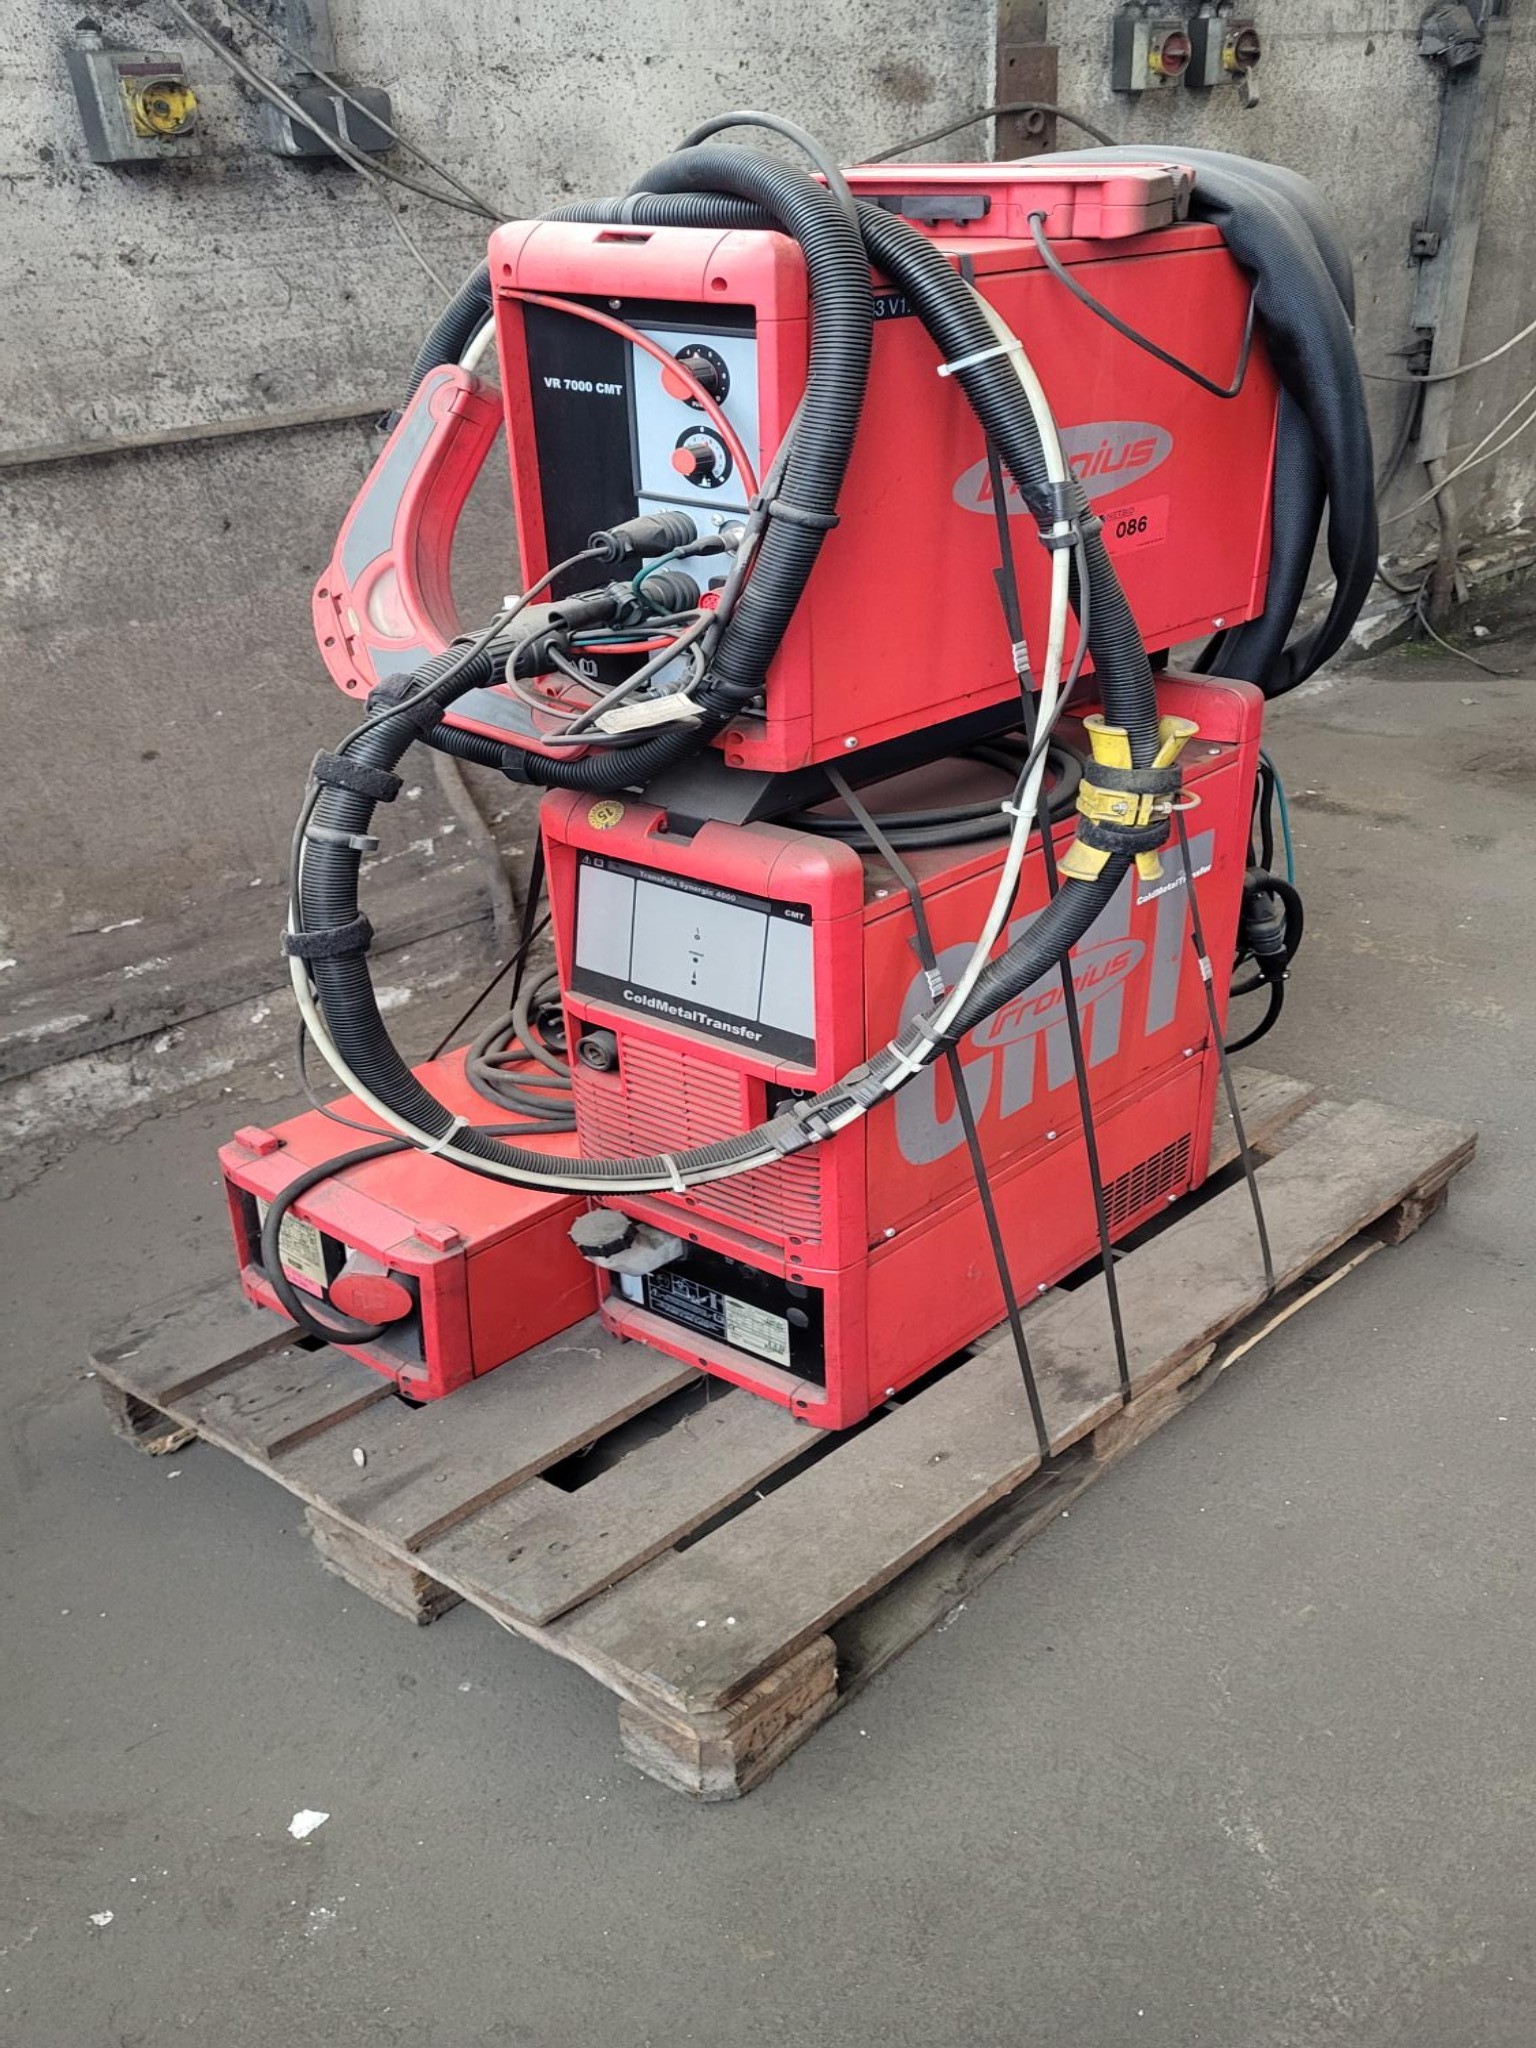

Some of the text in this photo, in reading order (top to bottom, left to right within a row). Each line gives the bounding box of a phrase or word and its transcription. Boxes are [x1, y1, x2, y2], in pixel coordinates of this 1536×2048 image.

[543, 376, 622, 395] VR 7000 CMT
[1116, 515, 1147, 538] 086
[784, 909, 805, 920] CMT
[622, 988, 763, 1042] ColdMetalTransfer
